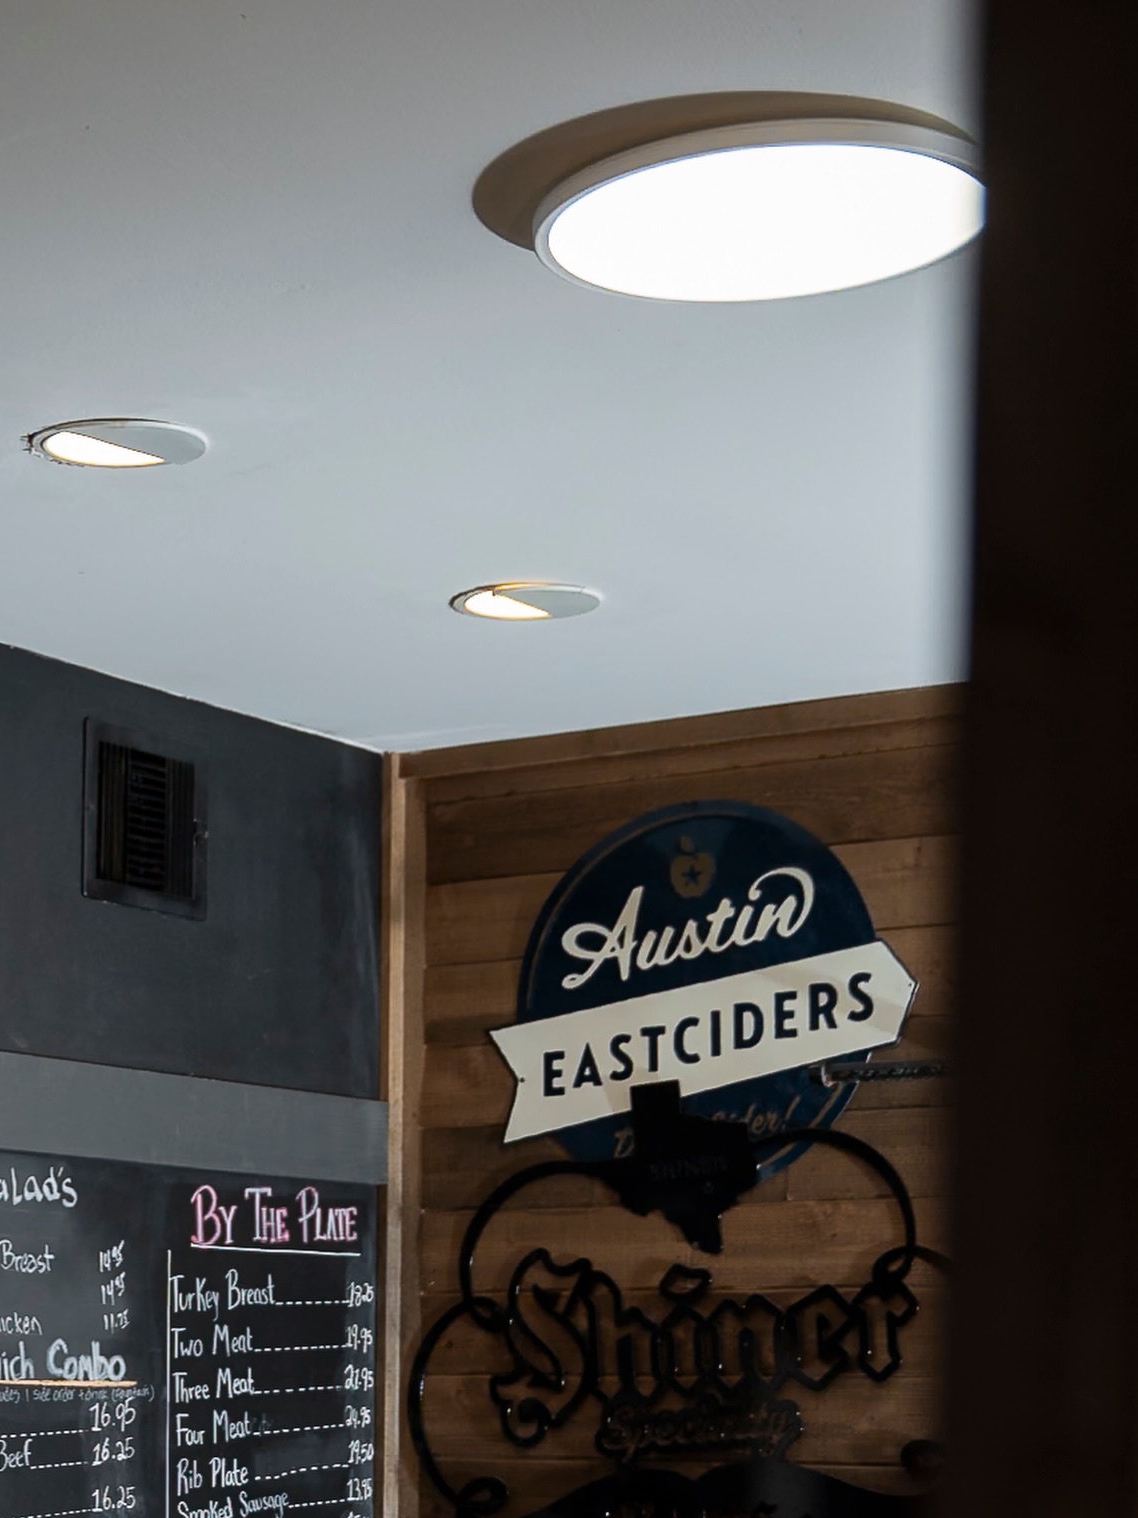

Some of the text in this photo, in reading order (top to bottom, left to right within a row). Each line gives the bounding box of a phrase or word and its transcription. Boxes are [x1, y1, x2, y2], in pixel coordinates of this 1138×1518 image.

[561, 867, 816, 990] Austin
[542, 971, 874, 1097] EASTCIDERS
[170, 1268, 275, 1321] Turkey Breast
[46, 1338, 126, 1381] Combo
[171, 1323, 373, 1358] Two Meat 19.95
[489, 1248, 919, 1447] Shiner
[172, 1364, 374, 1403] Three Meat 21.95
[89, 1398, 137, 1432] 16.95
[176, 1409, 251, 1446] Four Meat
[92, 1437, 135, 1466] 16.25
[177, 1457, 249, 1496] Rib Plate
[91, 1485, 136, 1512] 16.25
